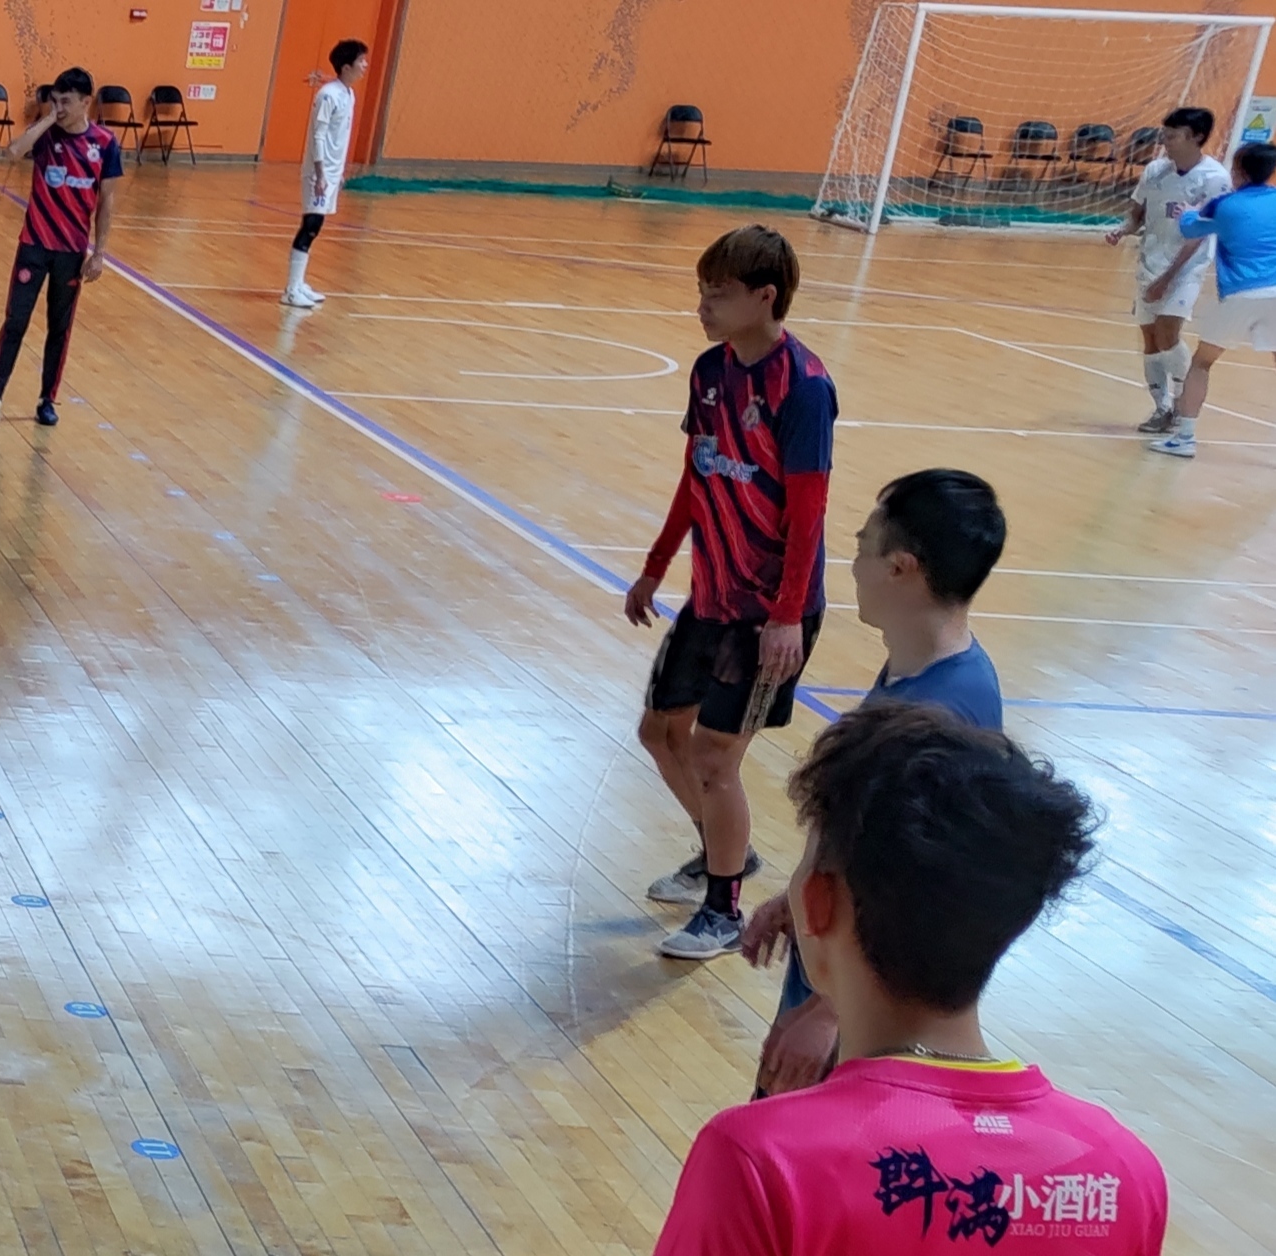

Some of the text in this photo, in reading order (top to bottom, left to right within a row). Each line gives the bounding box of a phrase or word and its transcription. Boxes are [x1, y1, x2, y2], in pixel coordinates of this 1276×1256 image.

[1010, 1223, 1110, 1238] XIAO JIU GUAN
